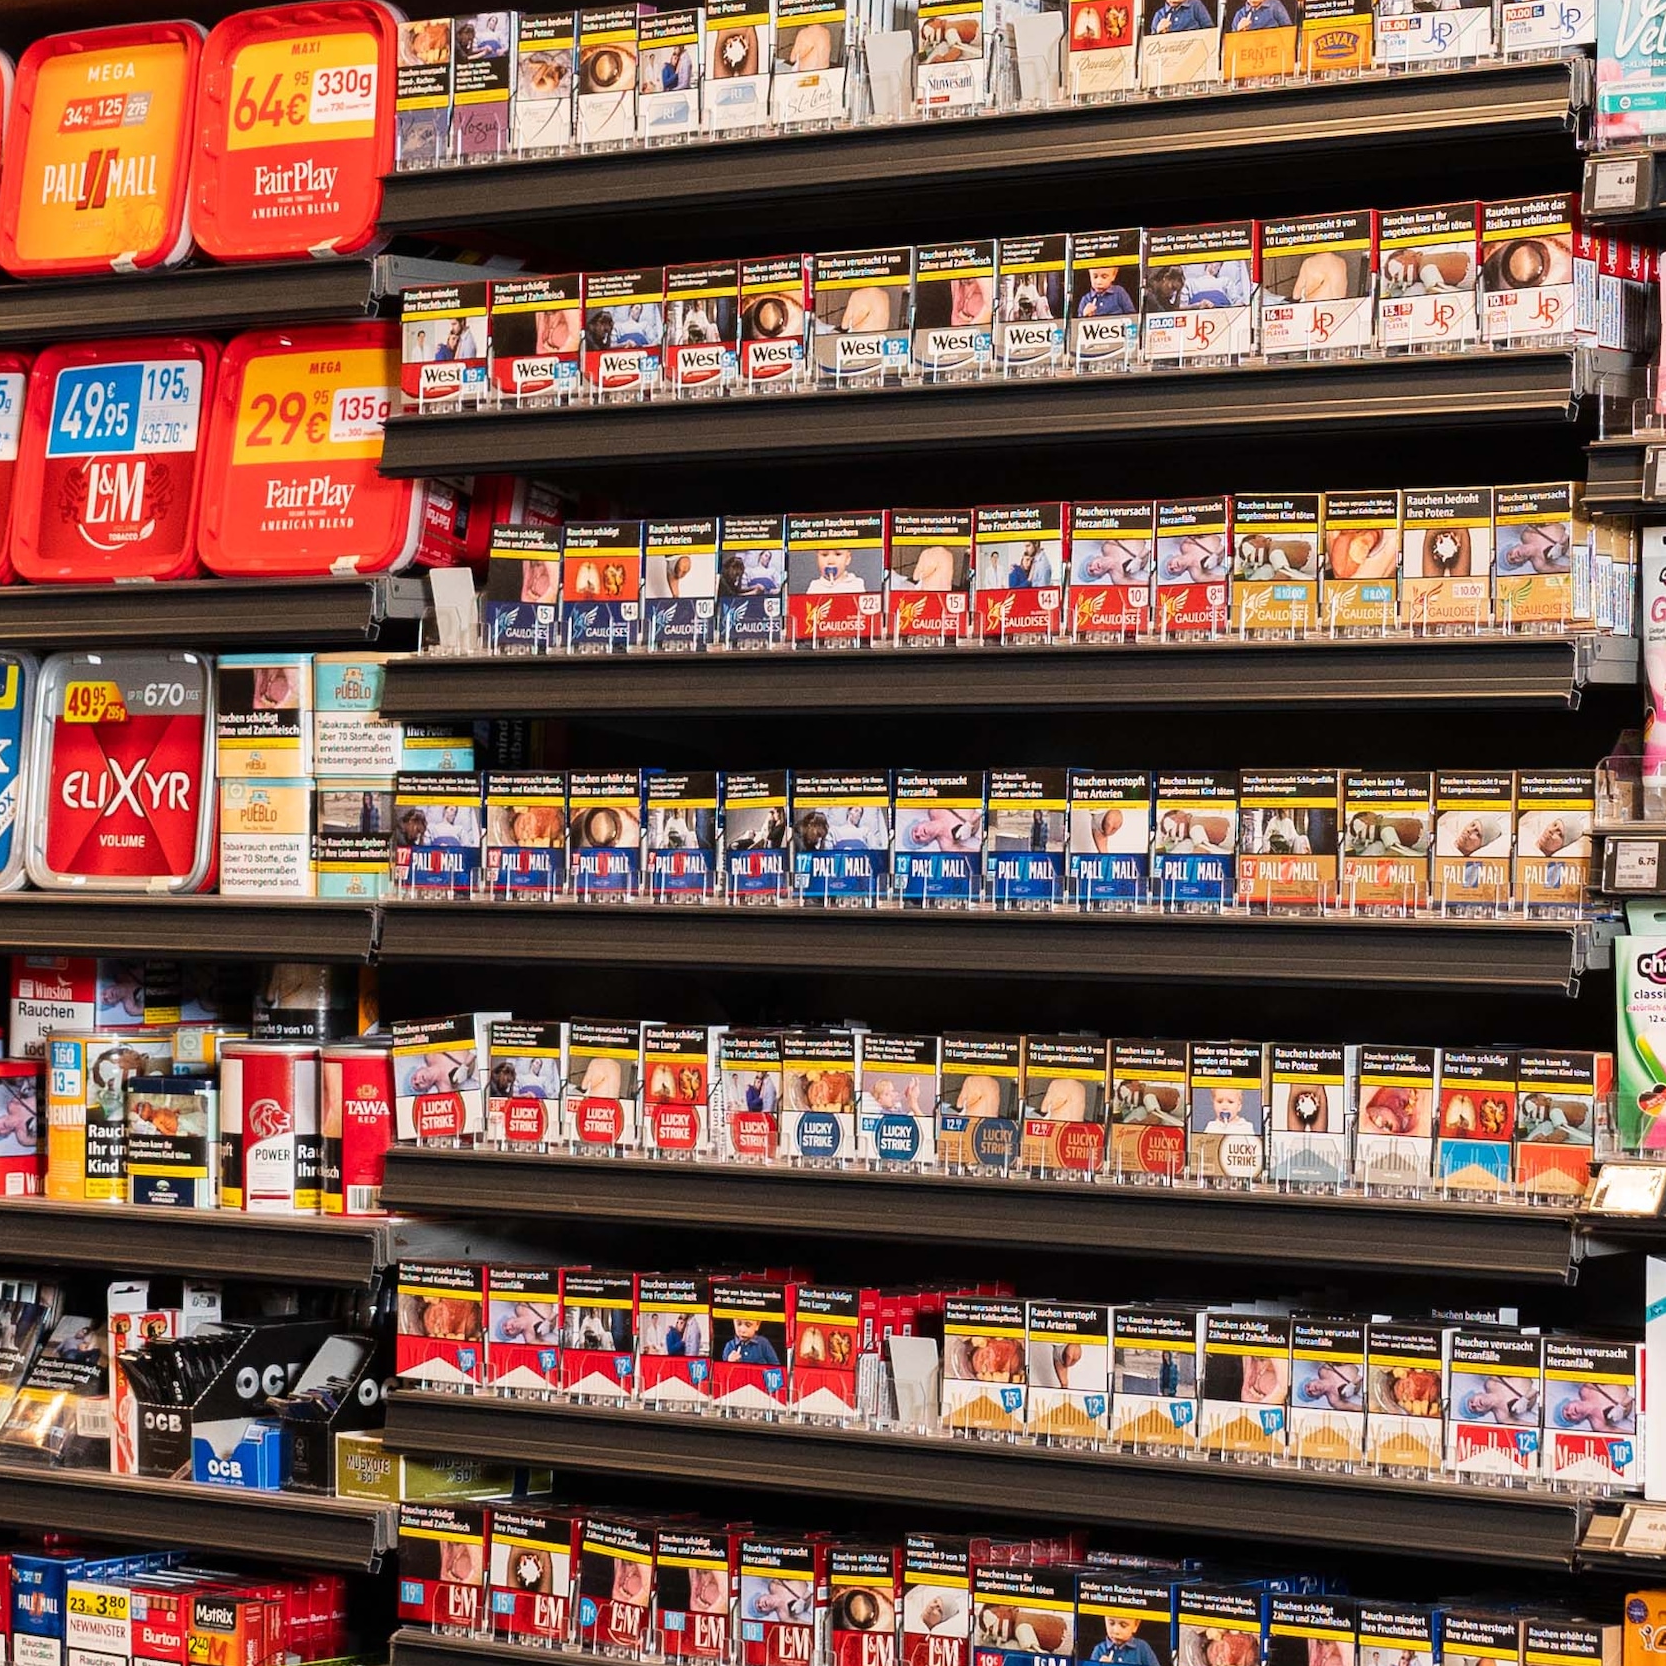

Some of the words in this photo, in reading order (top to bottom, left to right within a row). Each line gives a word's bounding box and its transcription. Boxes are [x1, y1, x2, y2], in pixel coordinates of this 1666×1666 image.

[291, 42, 321, 56] MAXI
[88, 63, 136, 82] MEGA
[43, 164, 86, 204] PALL
[110, 155, 156, 197] MALL
[425, 366, 462, 385] West
[86, 461, 145, 523] L&M
[1077, 609, 1140, 625] GAULOISES
[143, 682, 185, 708] 670
[62, 756, 190, 819] ELIXYR
[1637, 856, 1657, 868] 6.75
[345, 1099, 390, 1116] TAWA
[655, 1110, 690, 1127] LUCKY
[655, 1124, 690, 1140] STRIKE
[255, 1147, 291, 1162] POWER
[1454, 1336, 1489, 1350] Rauchen
[1492, 1339, 1533, 1351] verursacht
[1454, 1349, 1500, 1362] Herzanfälle
[70, 1618, 126, 1639] NEWMINSTER
